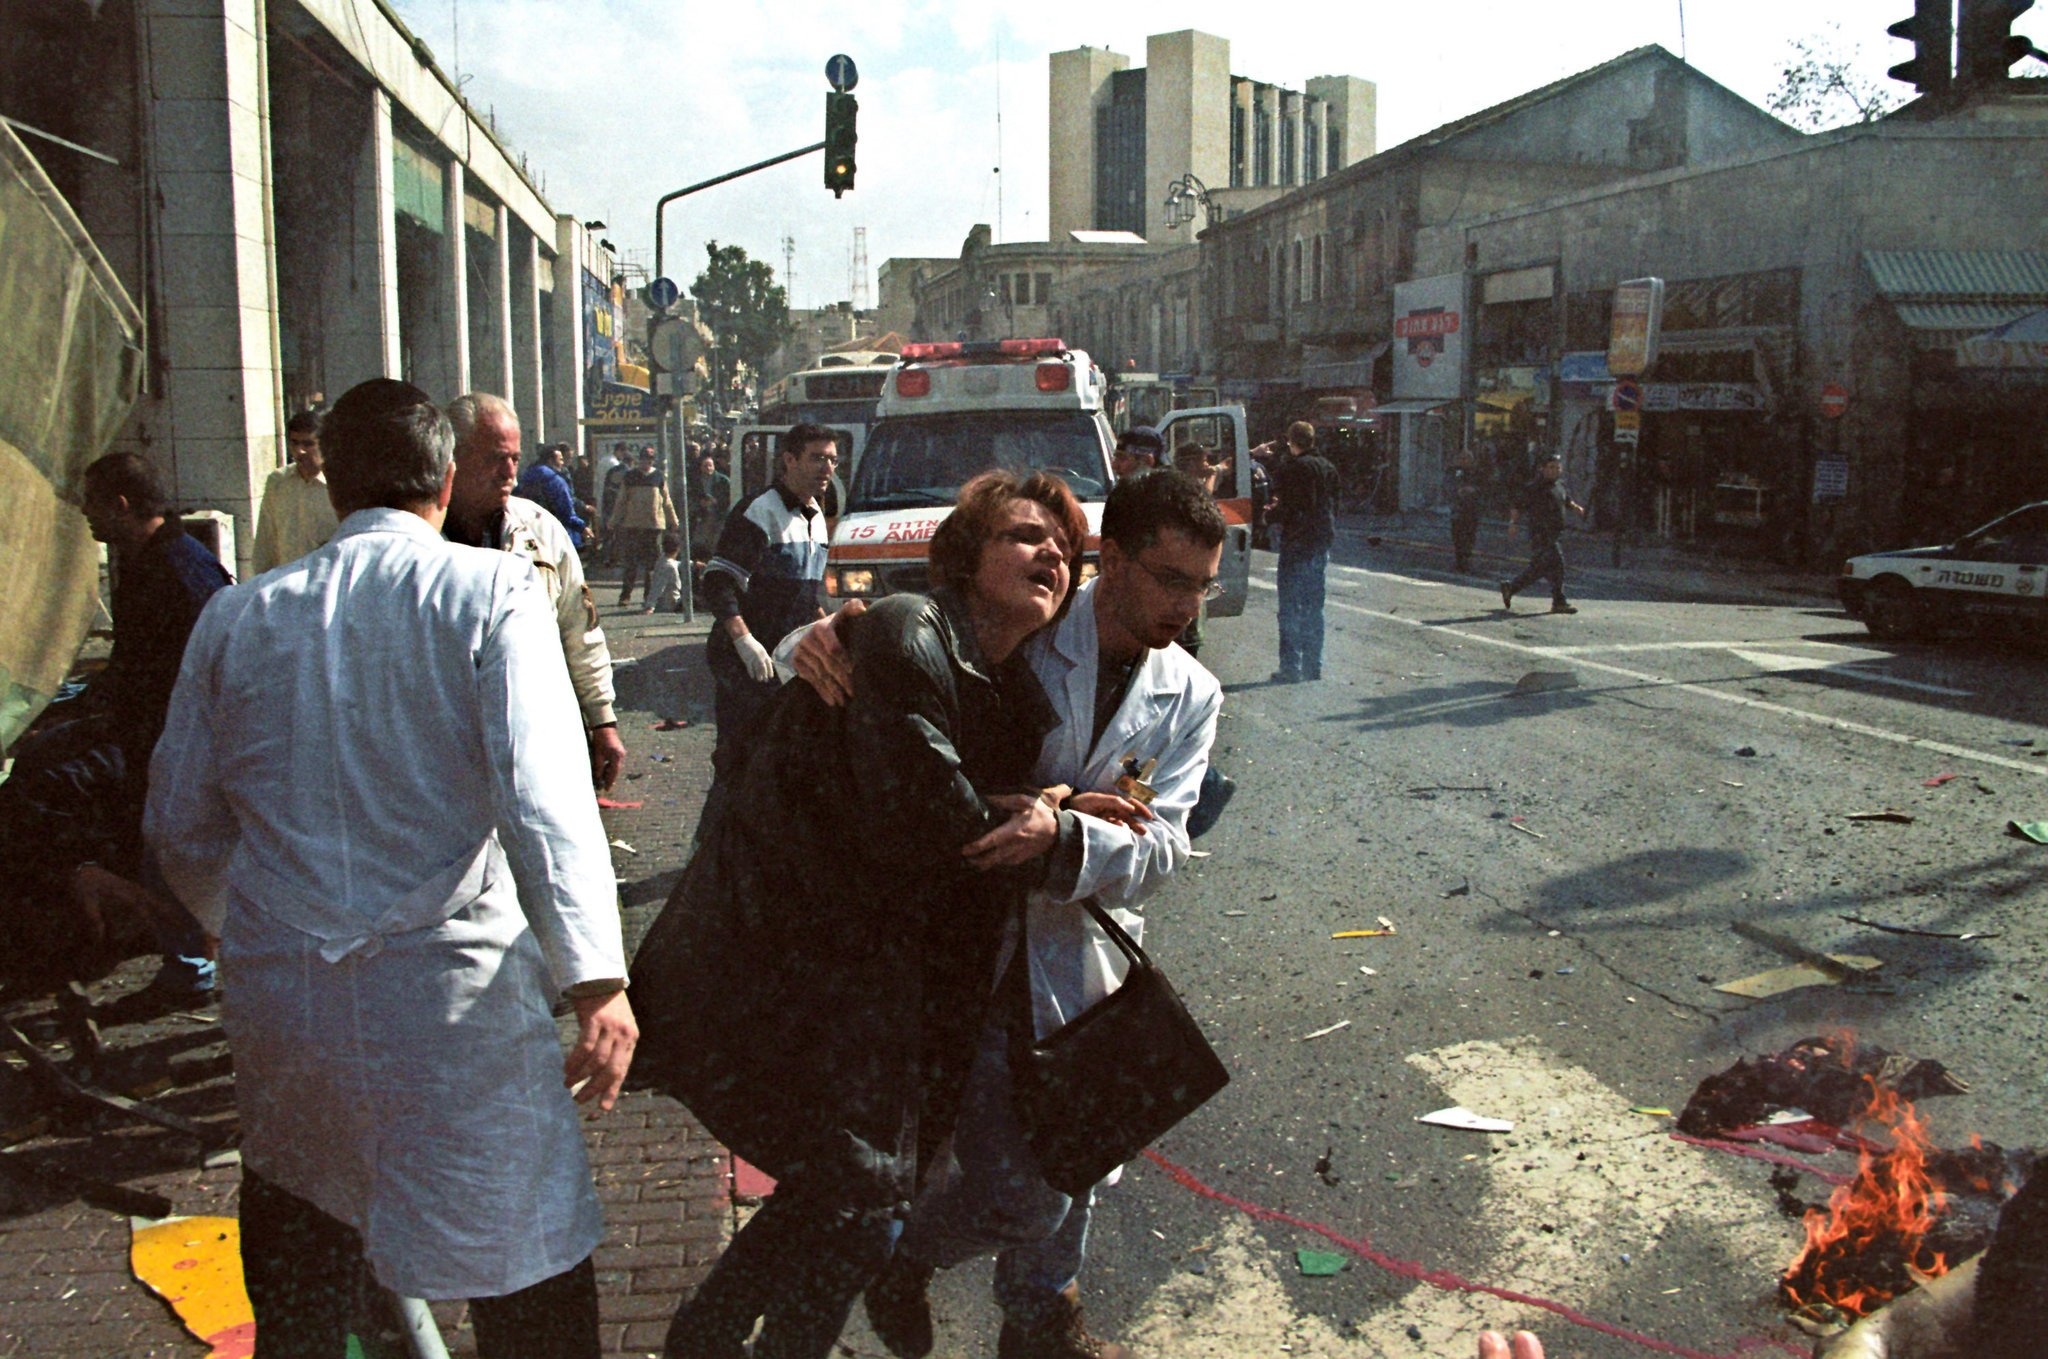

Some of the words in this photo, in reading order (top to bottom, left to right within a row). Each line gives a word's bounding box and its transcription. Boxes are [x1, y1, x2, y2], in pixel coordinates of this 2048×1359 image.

[888, 519, 939, 530] אדום
[850, 525, 877, 540] 15
[1938, 570, 2004, 588] משטרה
